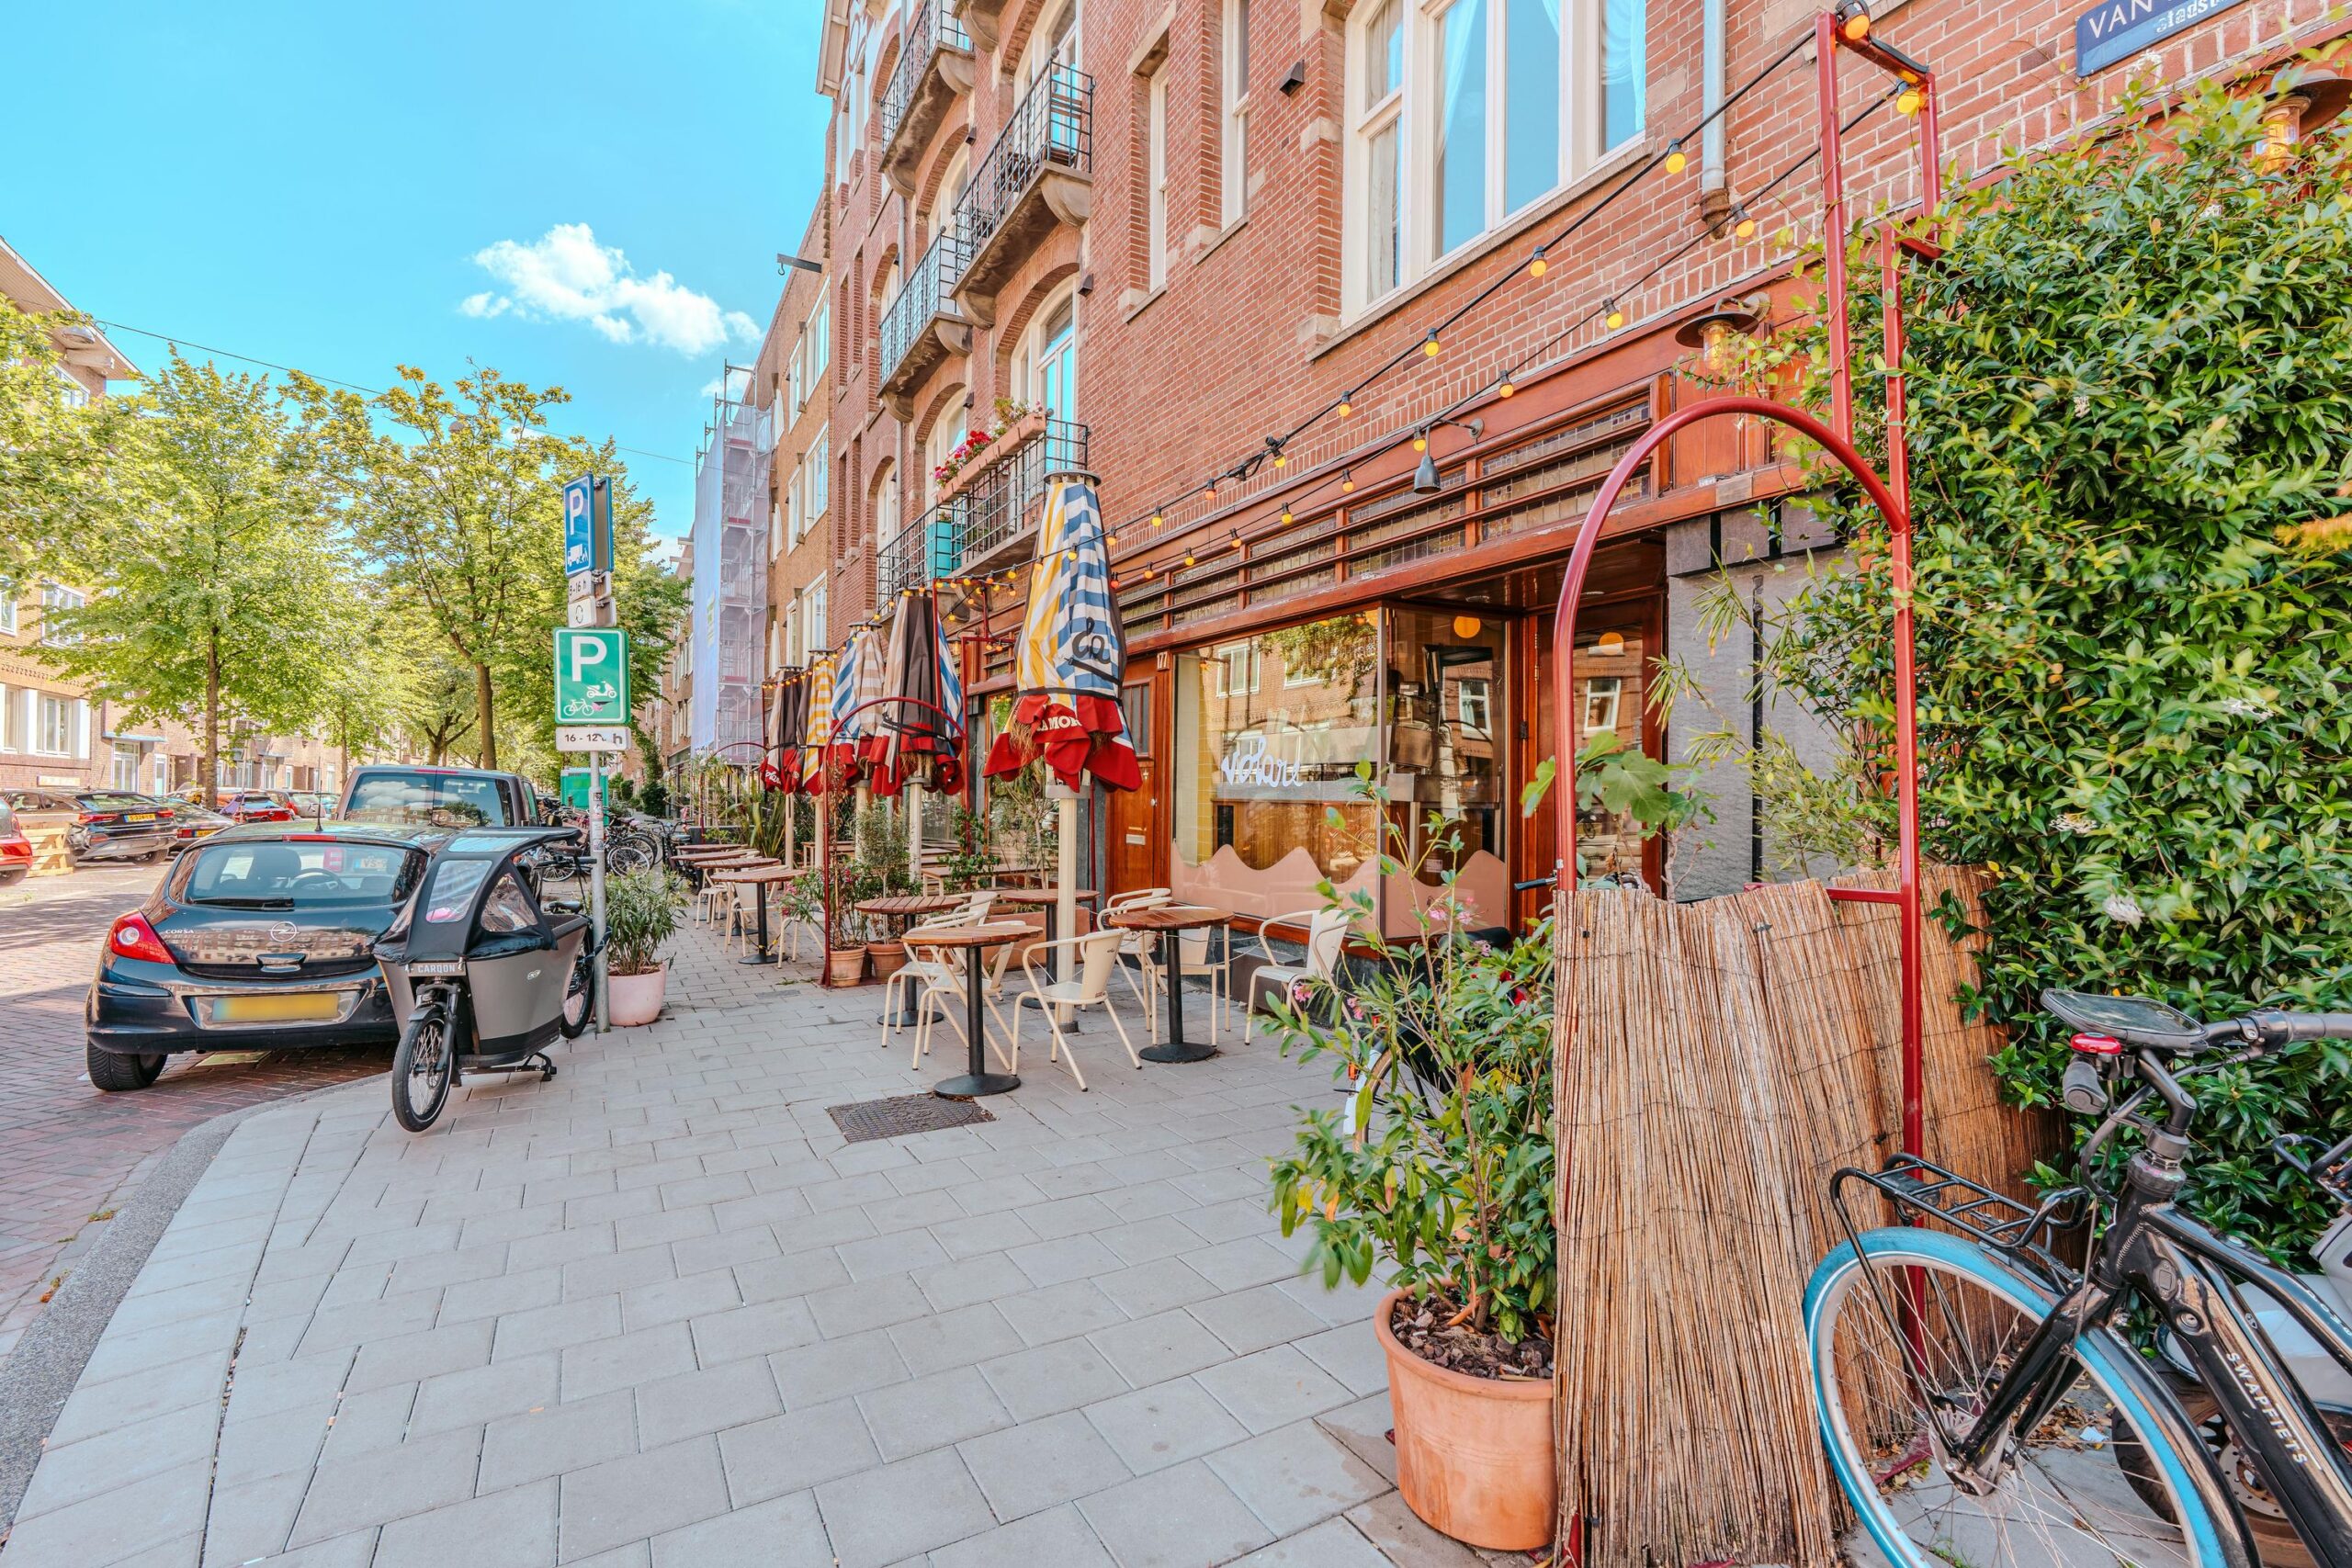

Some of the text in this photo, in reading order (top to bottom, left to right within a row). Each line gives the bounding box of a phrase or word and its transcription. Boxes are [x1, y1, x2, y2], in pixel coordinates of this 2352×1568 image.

[2089, 0, 2153, 39] VAN
[570, 488, 584, 536] P
[571, 636, 607, 682] P
[564, 734, 576, 742] 16
[418, 964, 456, 974] CARQON
[2225, 1351, 2308, 1464] SWAPFIETS
